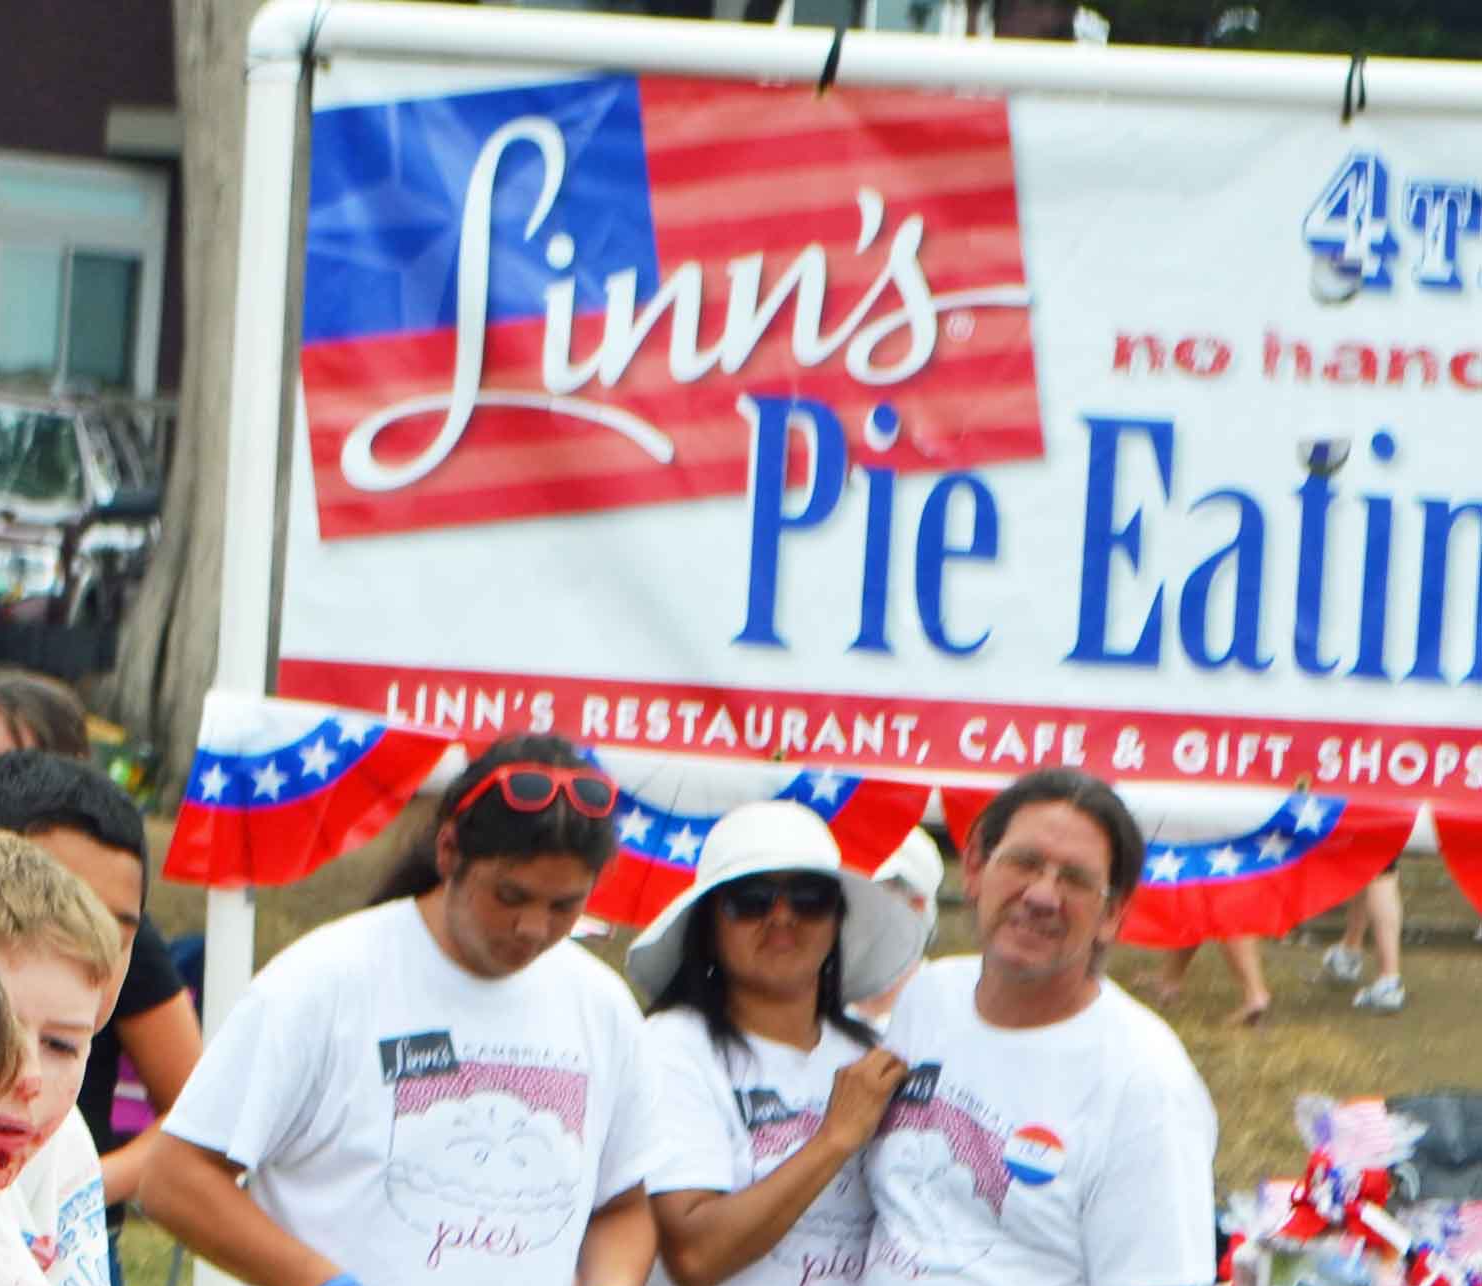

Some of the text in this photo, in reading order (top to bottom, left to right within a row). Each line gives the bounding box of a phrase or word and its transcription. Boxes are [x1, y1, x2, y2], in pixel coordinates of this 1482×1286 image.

[1302, 149, 1482, 292] 4T
[340, 115, 1030, 492] Linn's
[1112, 330, 1233, 379] no
[732, 393, 1482, 686] Pie Eatin
[386, 681, 555, 735] LINN'S
[581, 695, 932, 765] RESTAURANT,
[958, 716, 1087, 768] CAFE
[1111, 725, 1145, 772] &
[1172, 728, 1293, 779] GIFT
